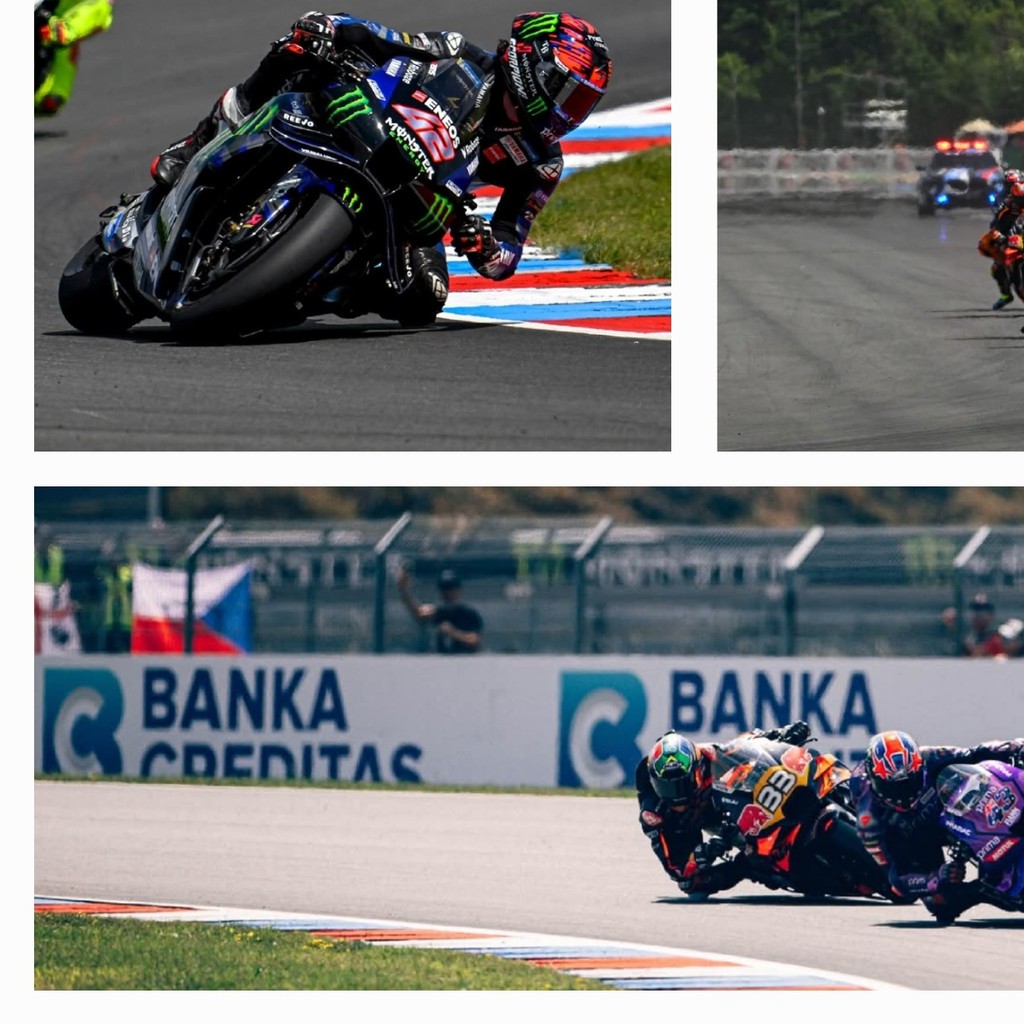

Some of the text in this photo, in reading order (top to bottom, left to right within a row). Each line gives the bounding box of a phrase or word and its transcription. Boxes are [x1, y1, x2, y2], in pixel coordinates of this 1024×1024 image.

[384, 116, 436, 181] MONSTER
[391, 103, 456, 163] 42
[423, 99, 462, 149] ENEOS
[142, 667, 349, 733] BANKA
[670, 670, 878, 736] BANKA
[757, 769, 798, 813] 33
[991, 840, 1015, 862] MOTUL
